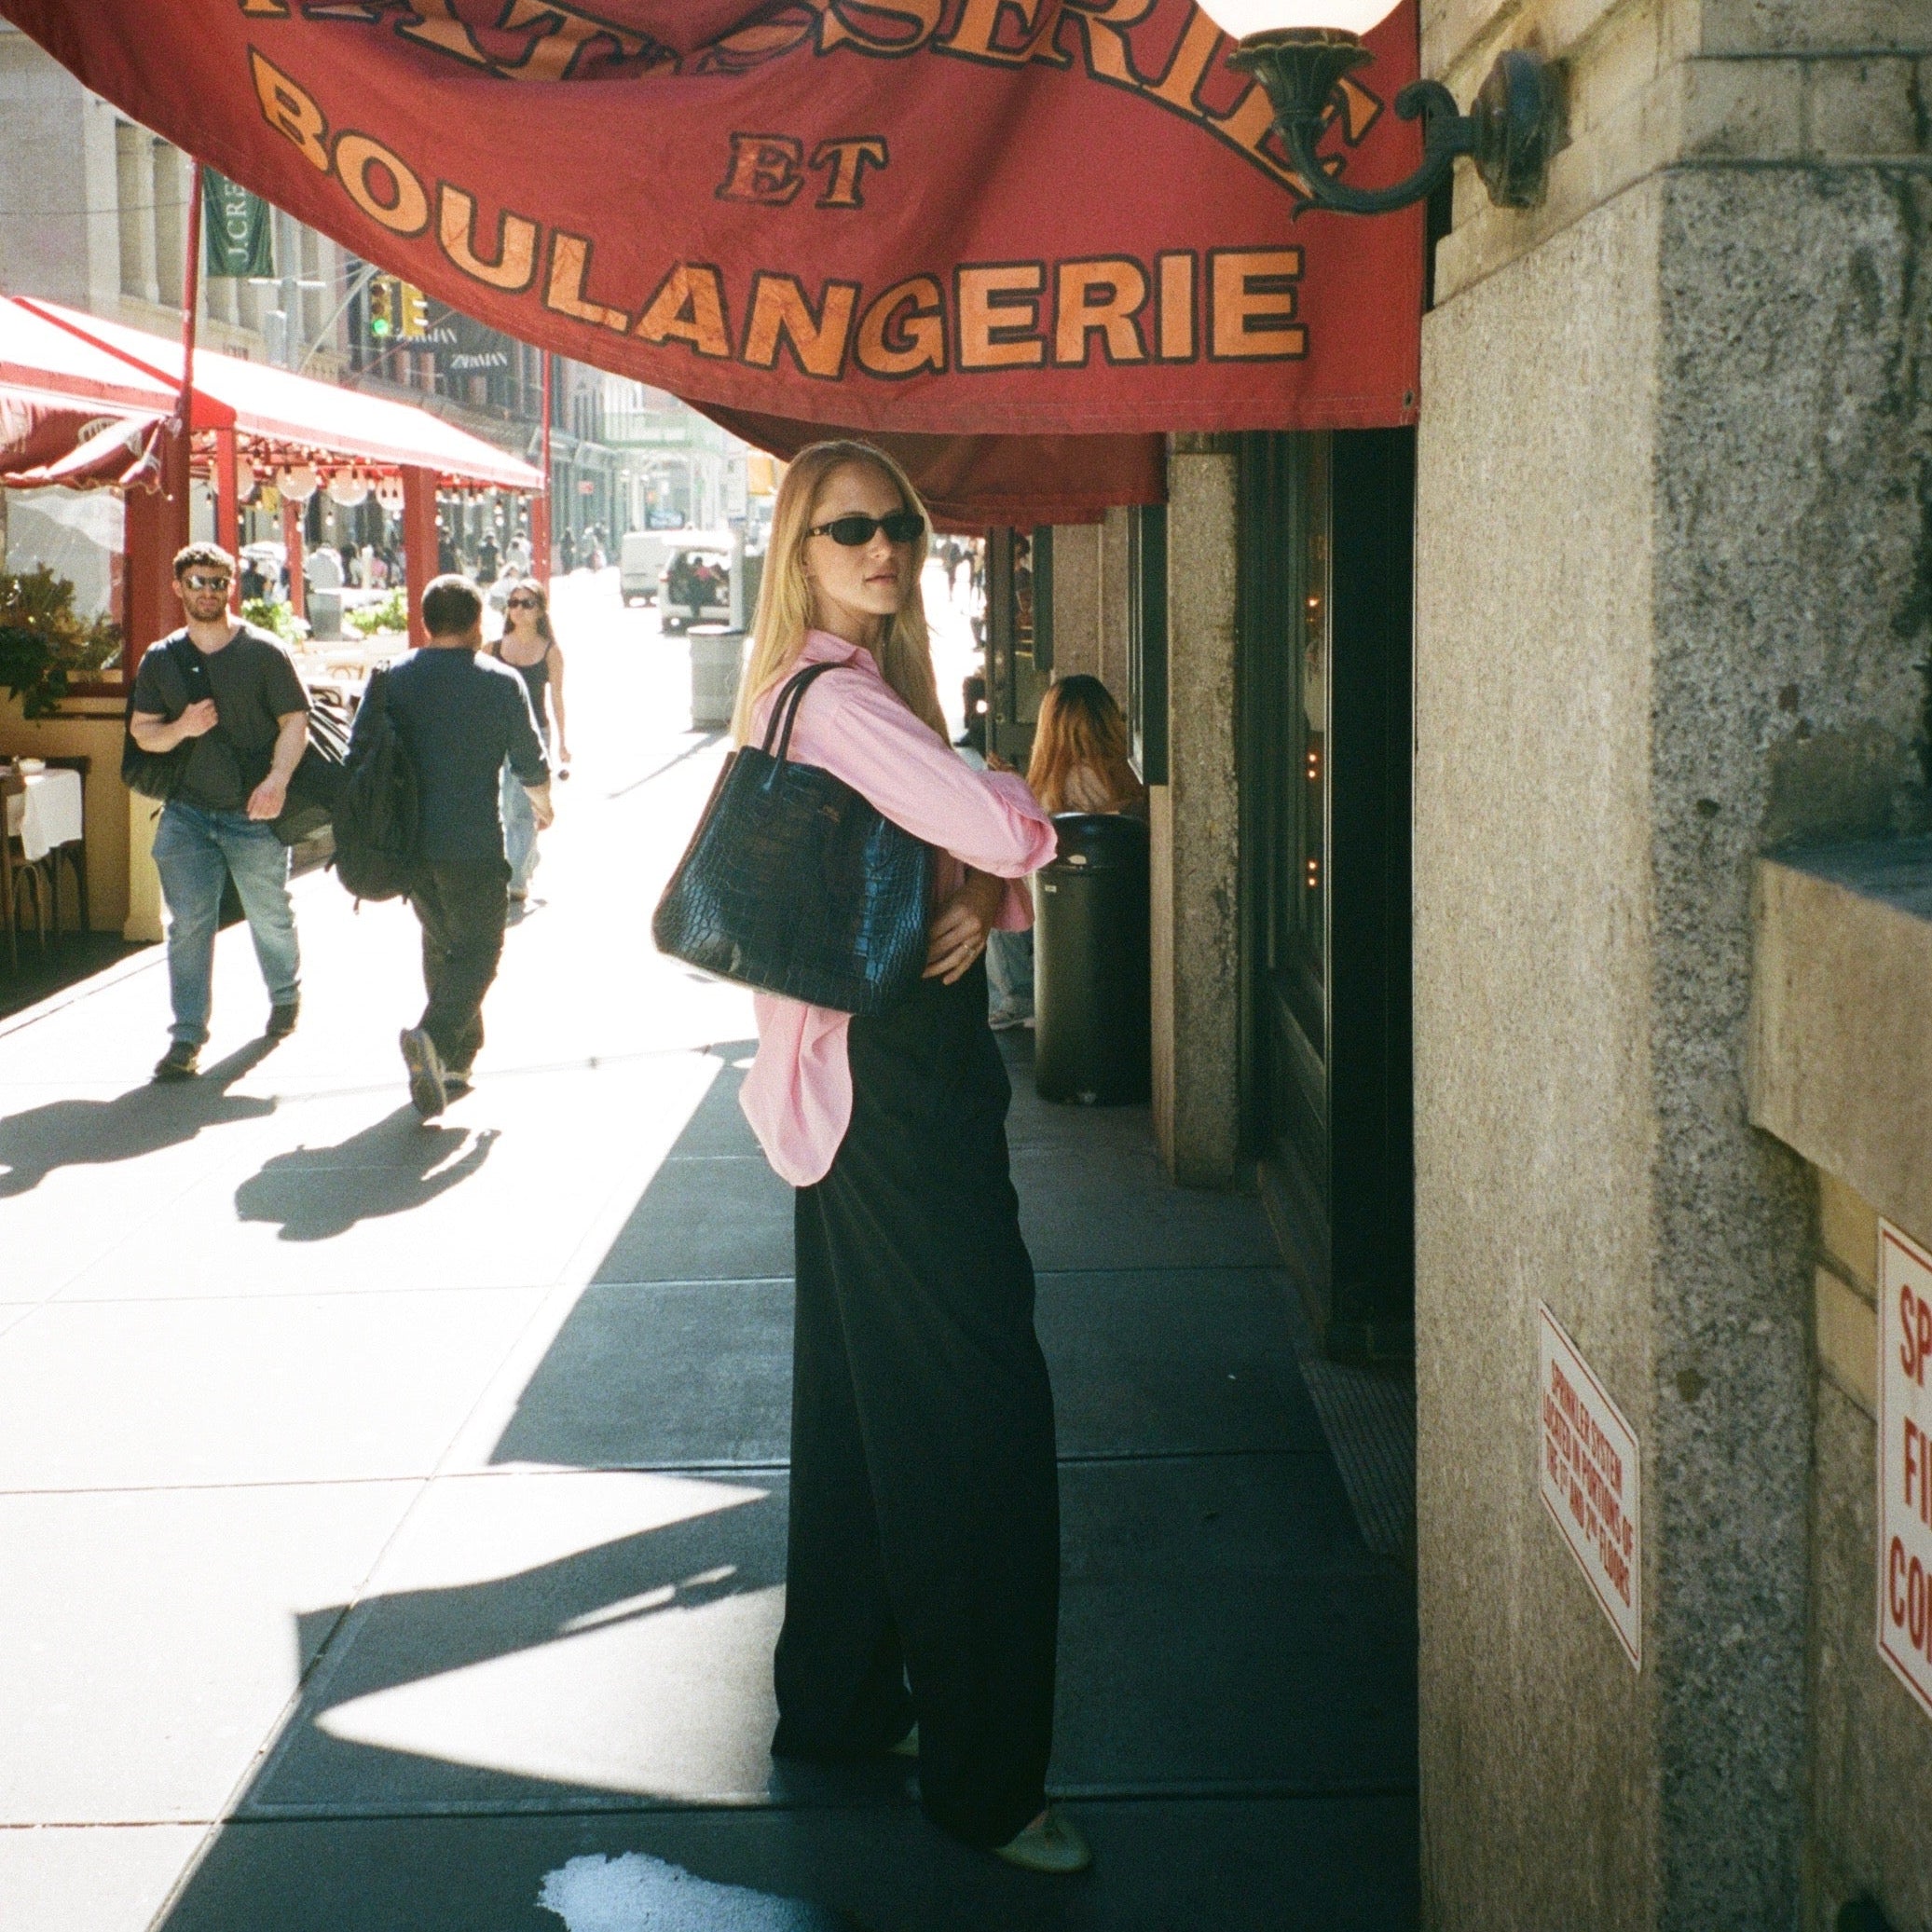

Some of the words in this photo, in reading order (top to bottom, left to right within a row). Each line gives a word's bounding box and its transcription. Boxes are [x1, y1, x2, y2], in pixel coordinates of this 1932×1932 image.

[224, 175, 250, 263] J.CRE
[247, 43, 1308, 381] BOULANGERIE
[714, 130, 889, 210] ET
[1543, 1389, 1570, 1462] LOCATED
[1583, 1451, 1621, 1545] PORTIONS
[1623, 1514, 1633, 1566] OF
[1553, 1360, 1589, 1447] SPRINKLER
[1593, 1418, 1622, 1499] SYSTEM
[1903, 1415, 1932, 1531] FI
